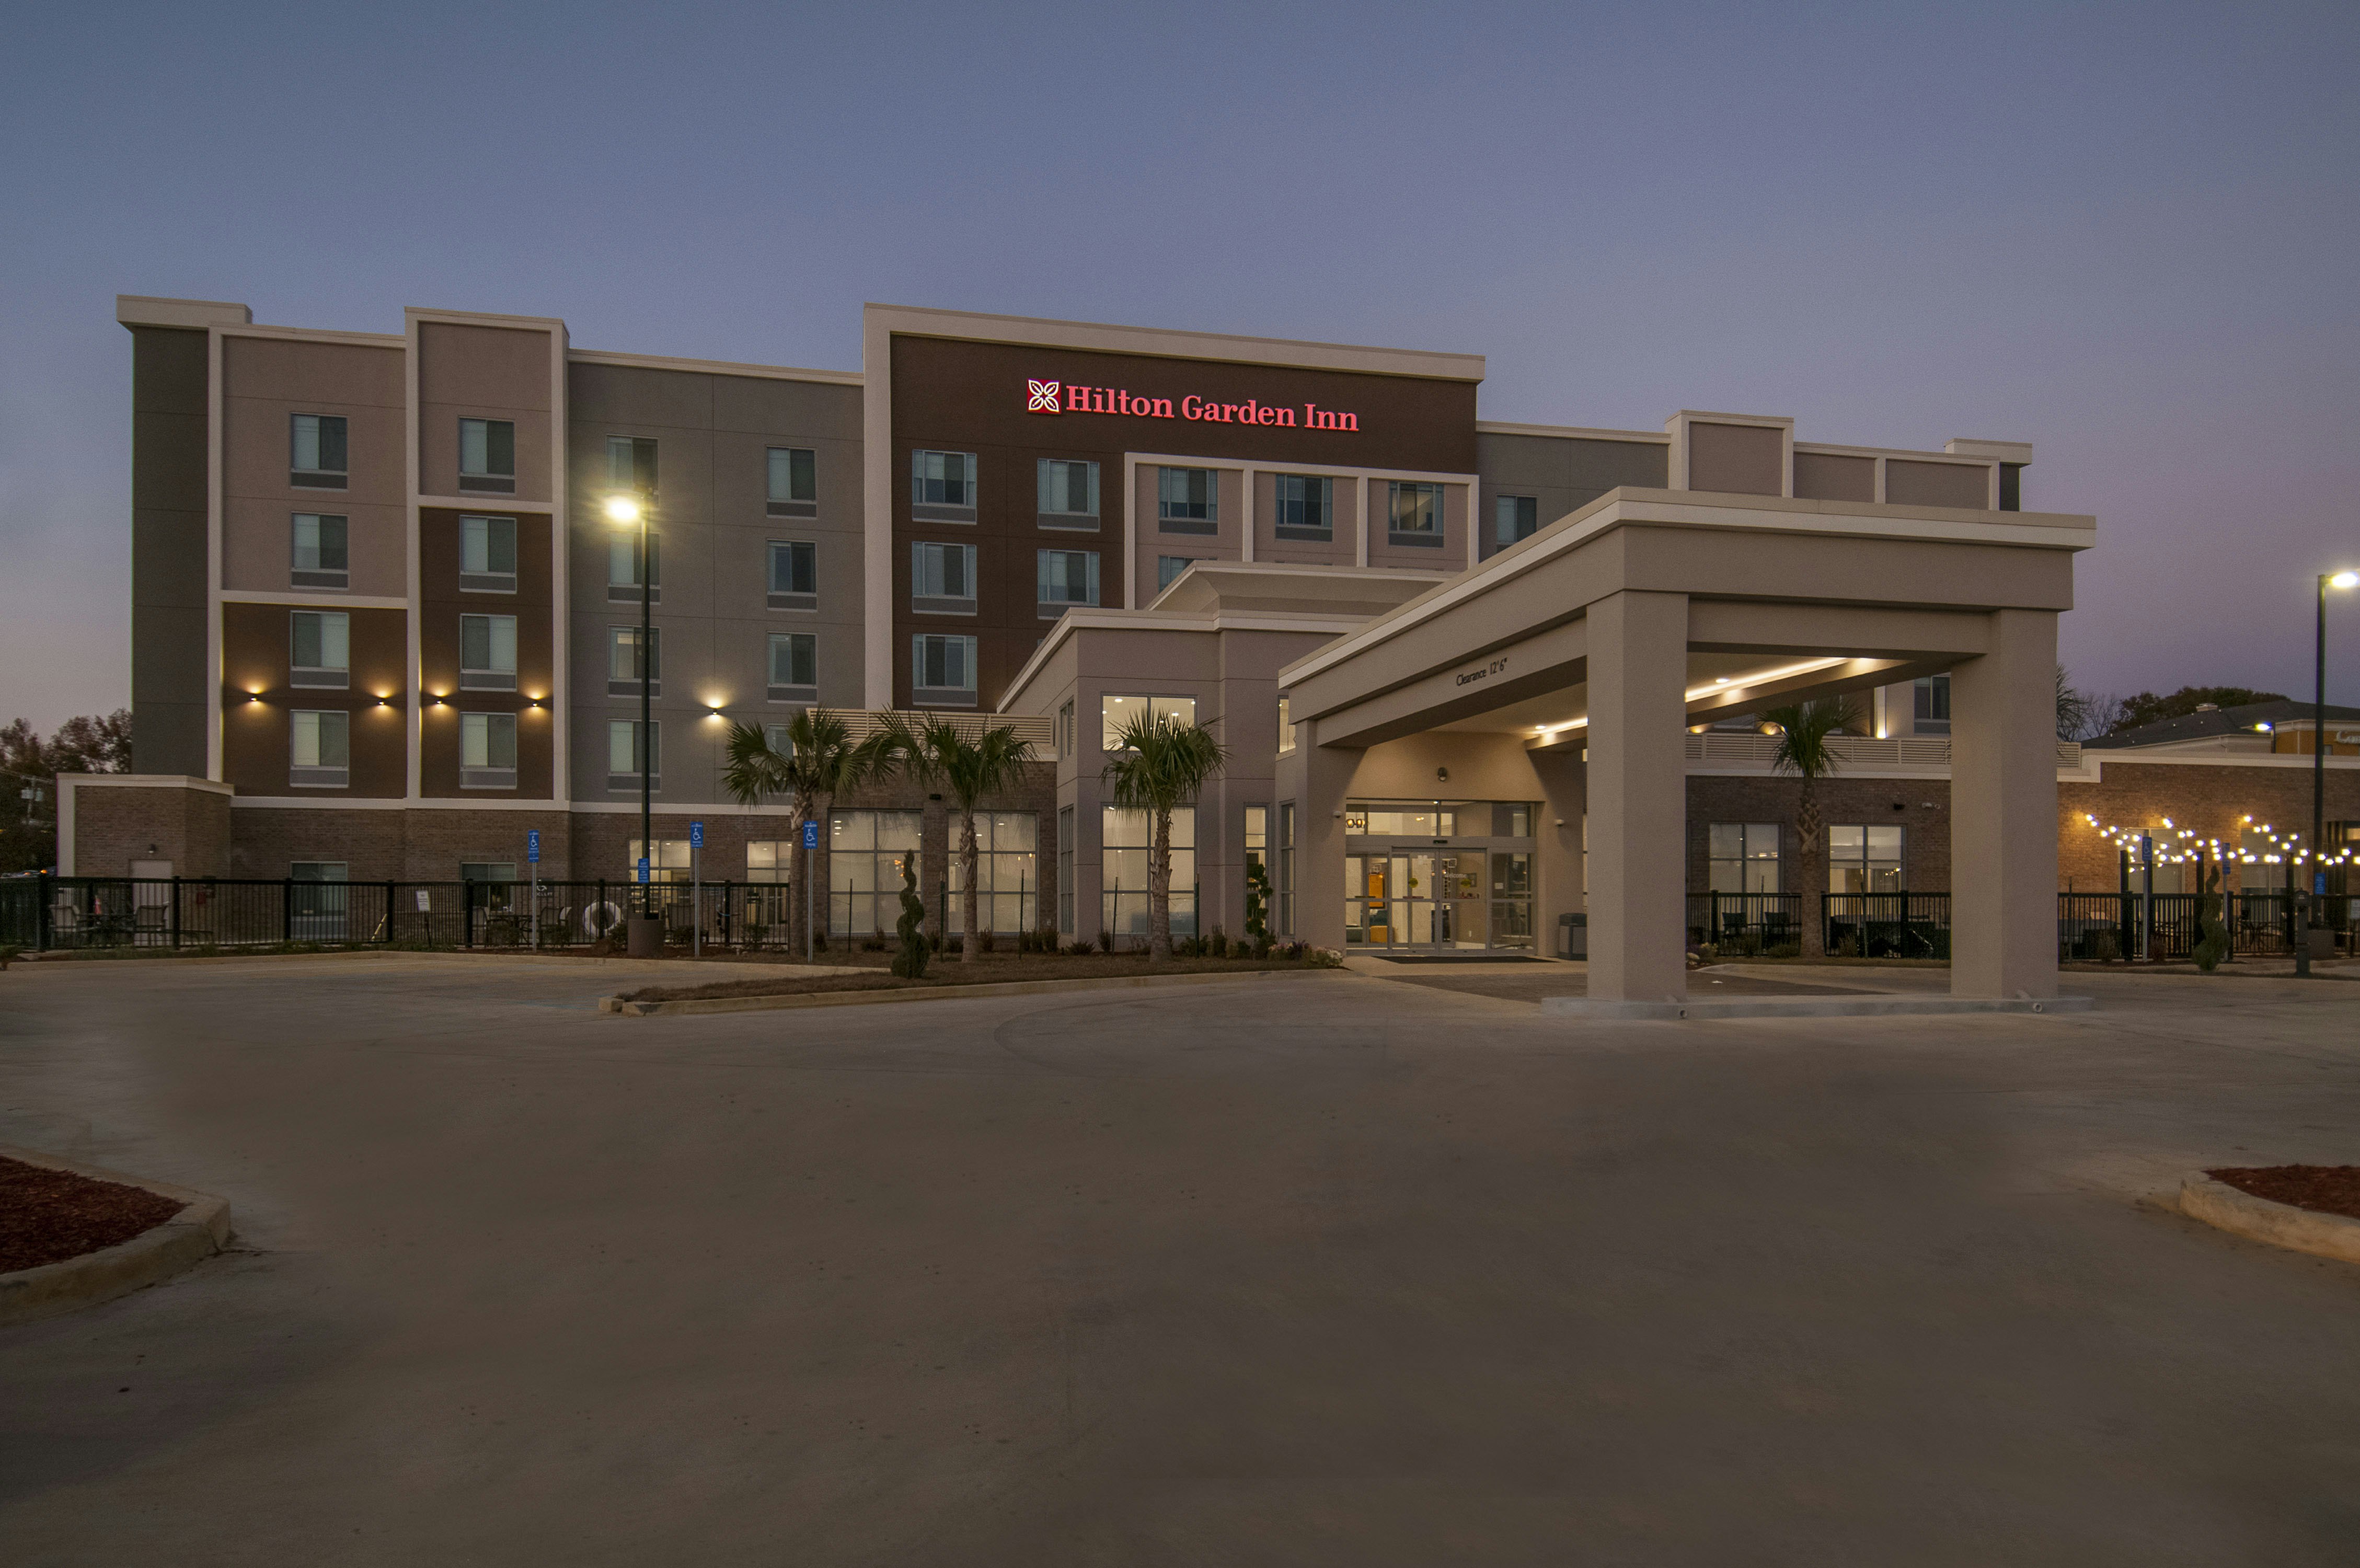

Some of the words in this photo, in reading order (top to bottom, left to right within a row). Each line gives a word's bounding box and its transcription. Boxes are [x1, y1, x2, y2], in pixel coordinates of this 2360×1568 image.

[1066, 385, 1175, 419] Hilton
[1181, 395, 1297, 427] Garden
[1304, 403, 1360, 432] Inn
[1456, 668, 1487, 686] Clearance
